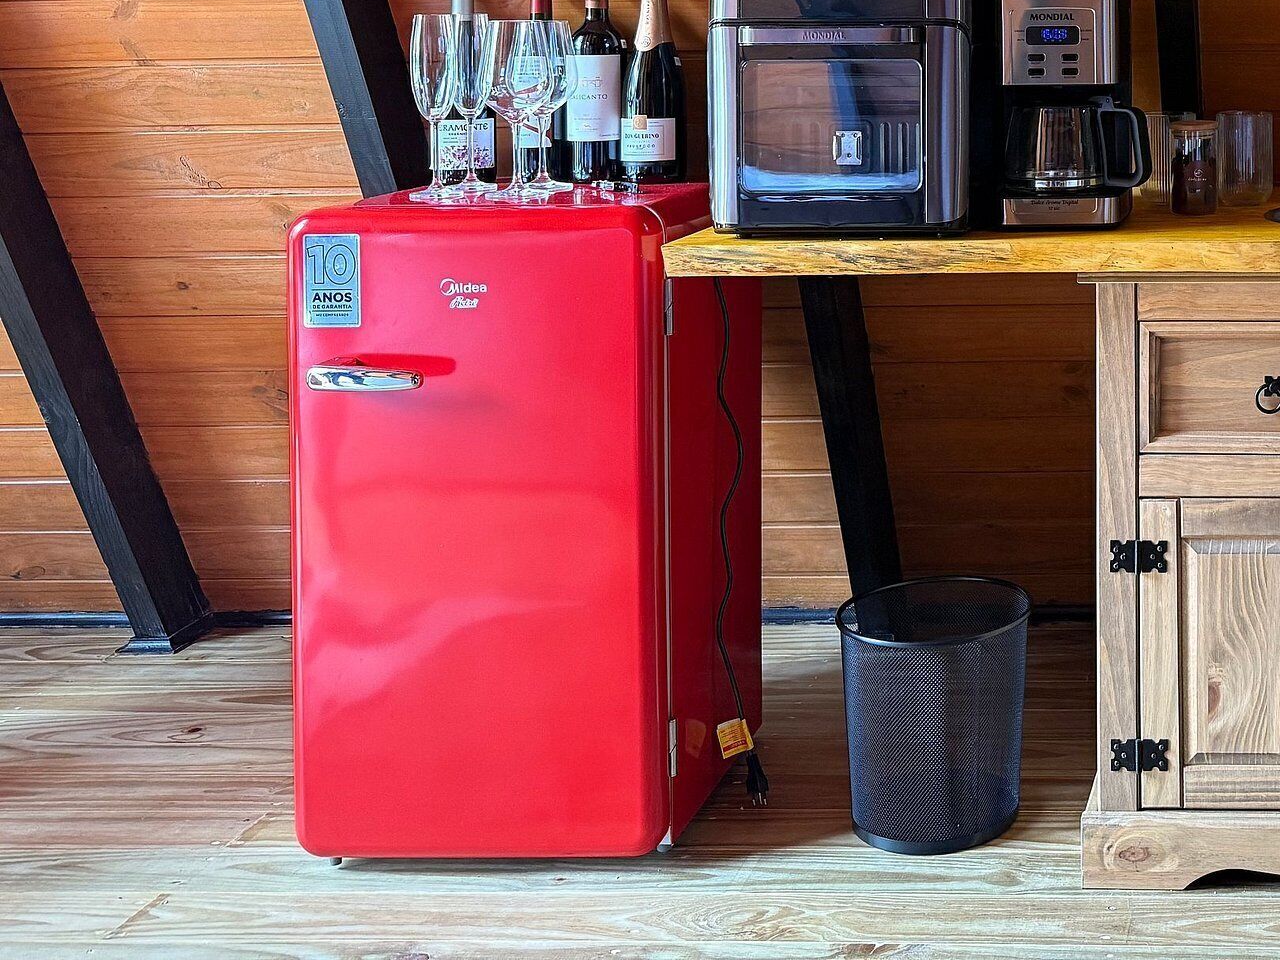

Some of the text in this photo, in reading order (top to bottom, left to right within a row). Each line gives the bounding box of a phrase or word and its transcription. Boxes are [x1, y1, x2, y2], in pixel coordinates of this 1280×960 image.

[1029, 13, 1075, 21] MONDIAL
[801, 31, 847, 40] MONDIAL
[306, 244, 356, 285] 10
[440, 278, 488, 295] Midea
[312, 292, 352, 303] ANOS
